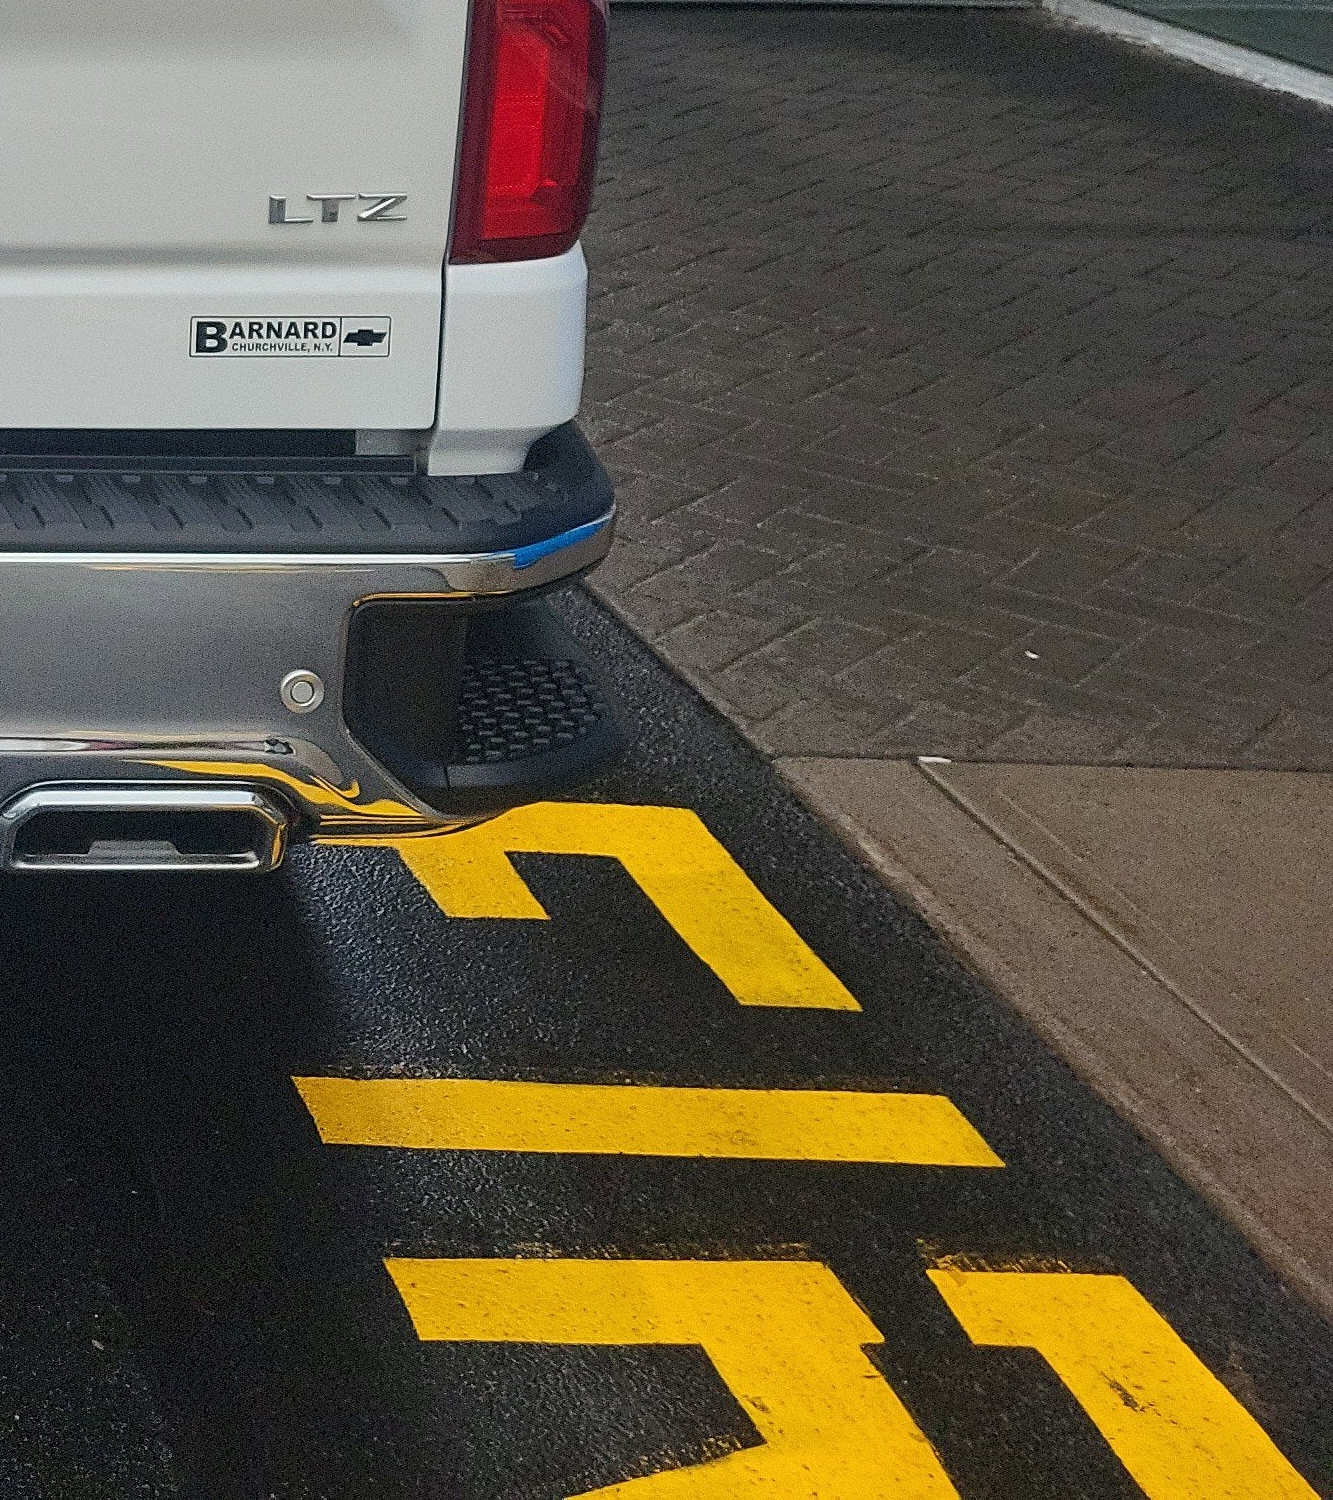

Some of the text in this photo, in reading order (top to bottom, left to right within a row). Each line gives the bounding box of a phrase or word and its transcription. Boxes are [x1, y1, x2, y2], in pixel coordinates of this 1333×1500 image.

[268, 191, 408, 224] LTZ
[195, 320, 338, 354] BARNARD
[232, 342, 333, 354] CHURCHVILLE, N.Y.
